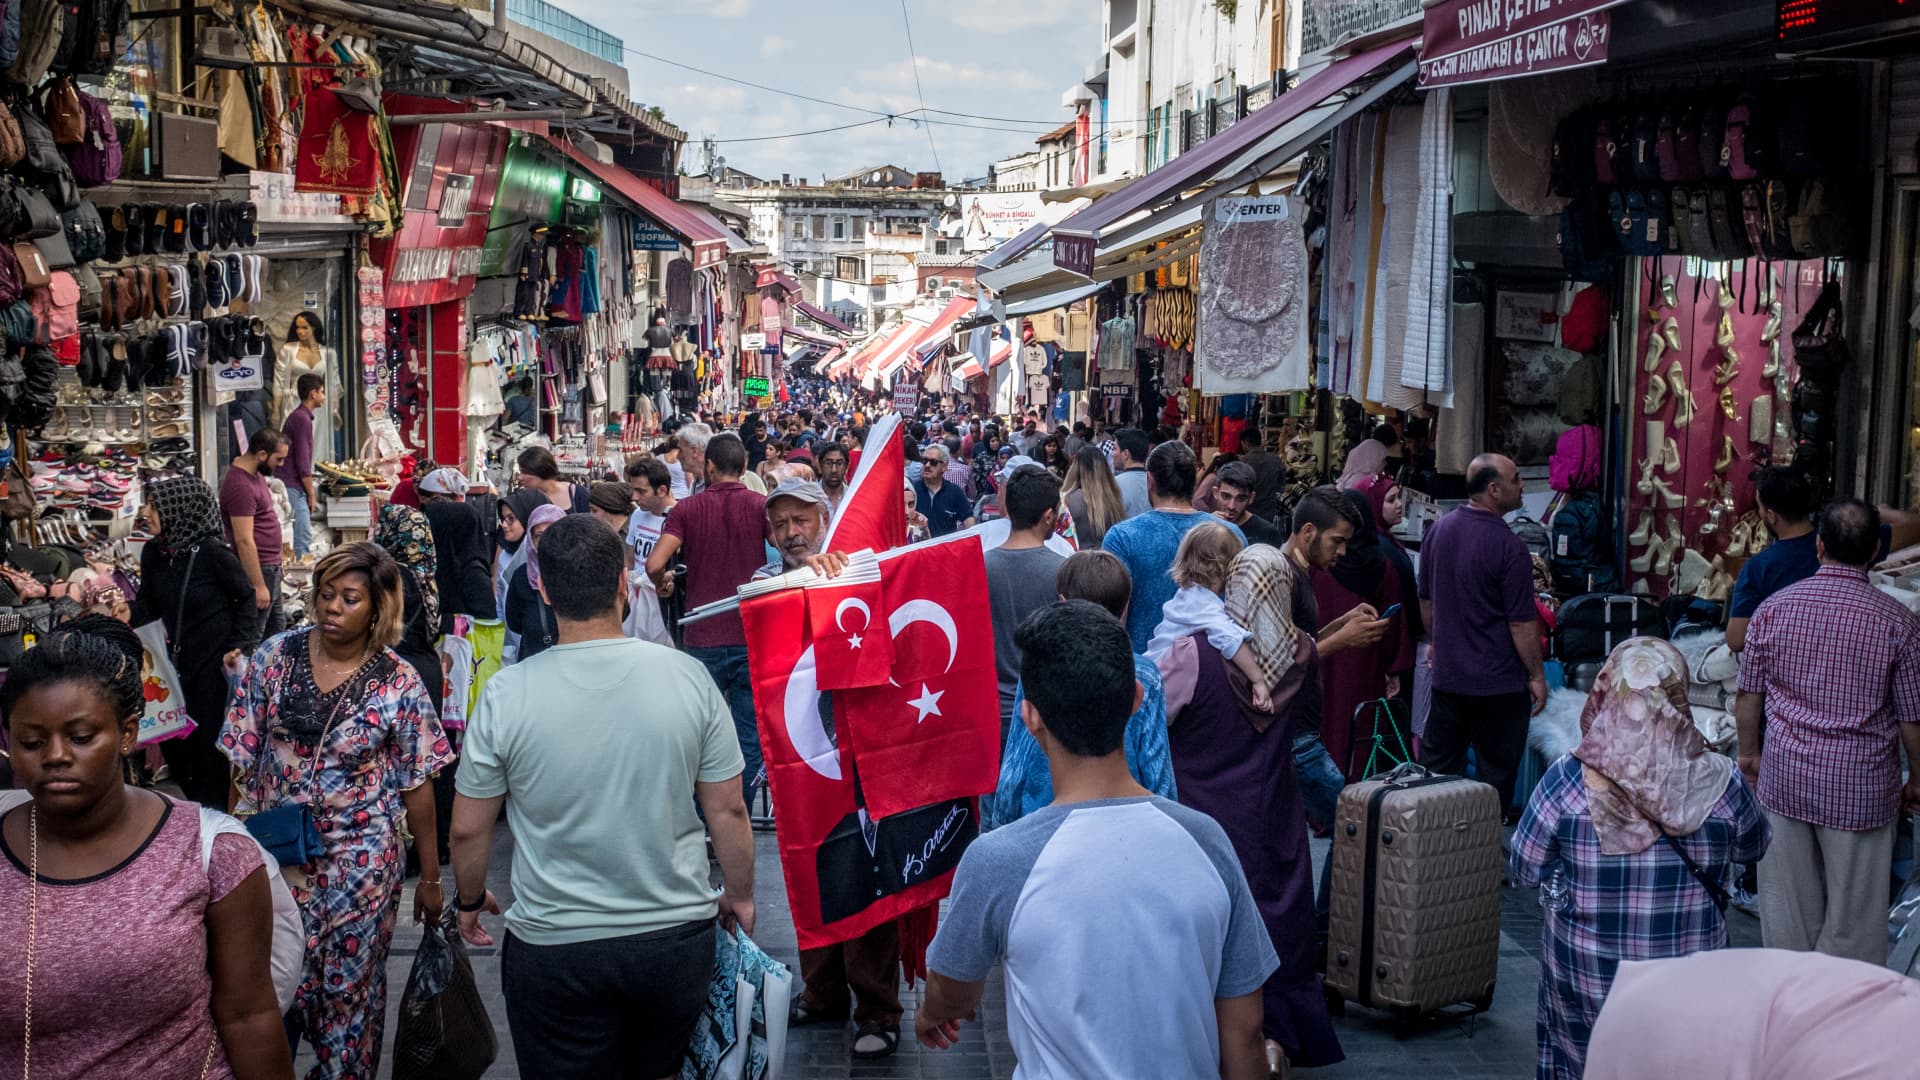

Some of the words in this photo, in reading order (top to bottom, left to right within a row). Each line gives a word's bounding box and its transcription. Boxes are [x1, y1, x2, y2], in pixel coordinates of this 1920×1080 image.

[1458, 0, 1500, 39] PINAR
[1527, 25, 1567, 70] ÇANTA
[1103, 386, 1128, 395] NBB
